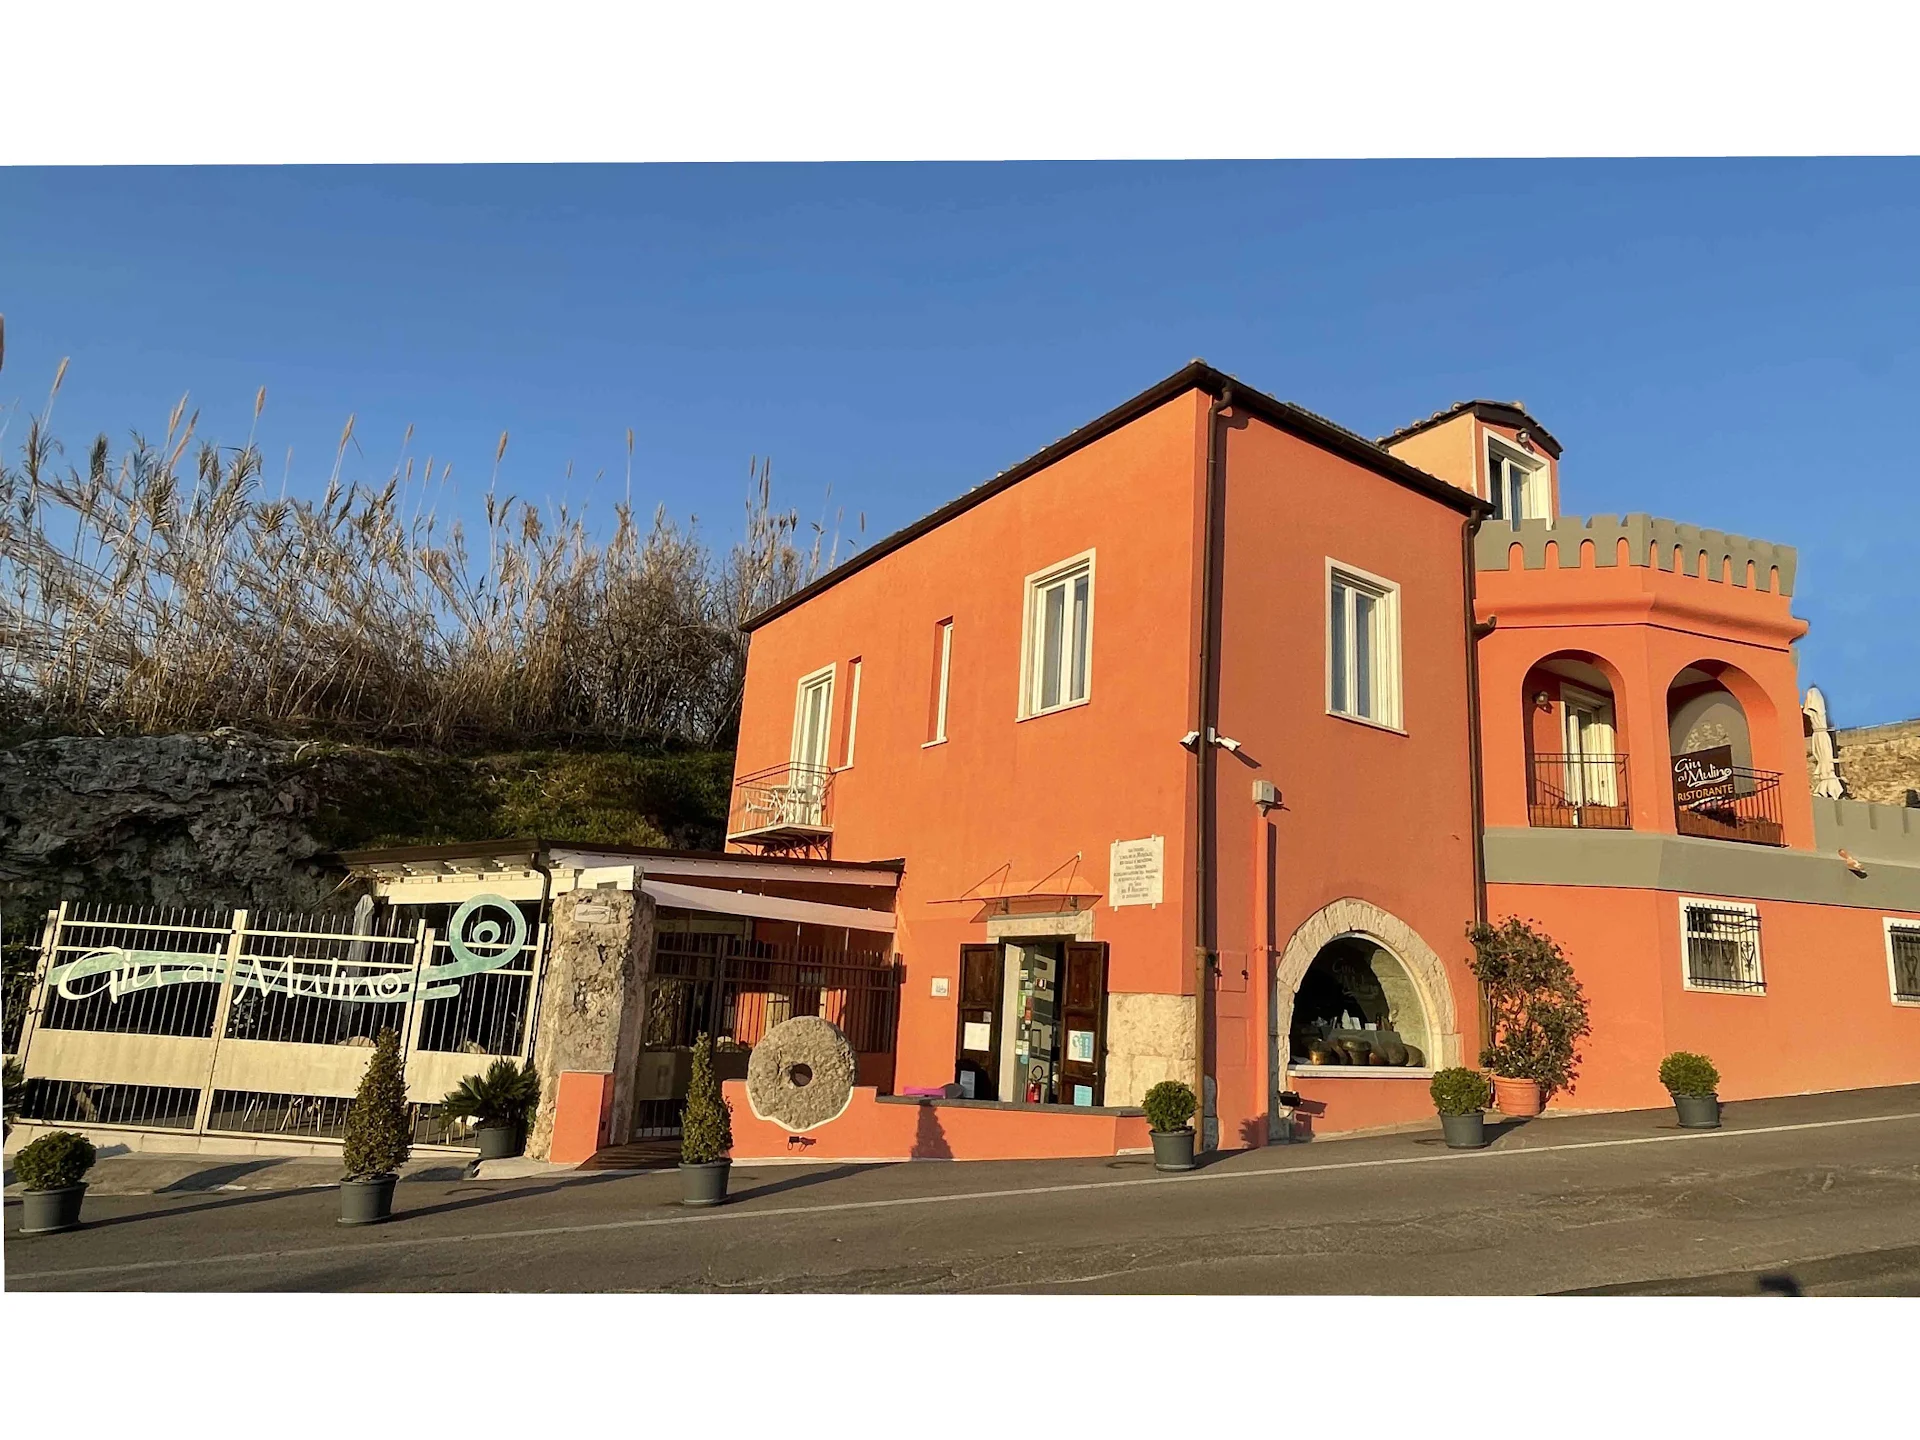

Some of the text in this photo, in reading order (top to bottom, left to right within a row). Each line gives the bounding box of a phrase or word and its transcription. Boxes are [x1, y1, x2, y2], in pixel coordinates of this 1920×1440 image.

[1678, 763, 1732, 788] al Mulino
[1677, 783, 1734, 802] RISTORANTE
[181, 942, 222, 983] al
[232, 954, 401, 1005] Mulino
